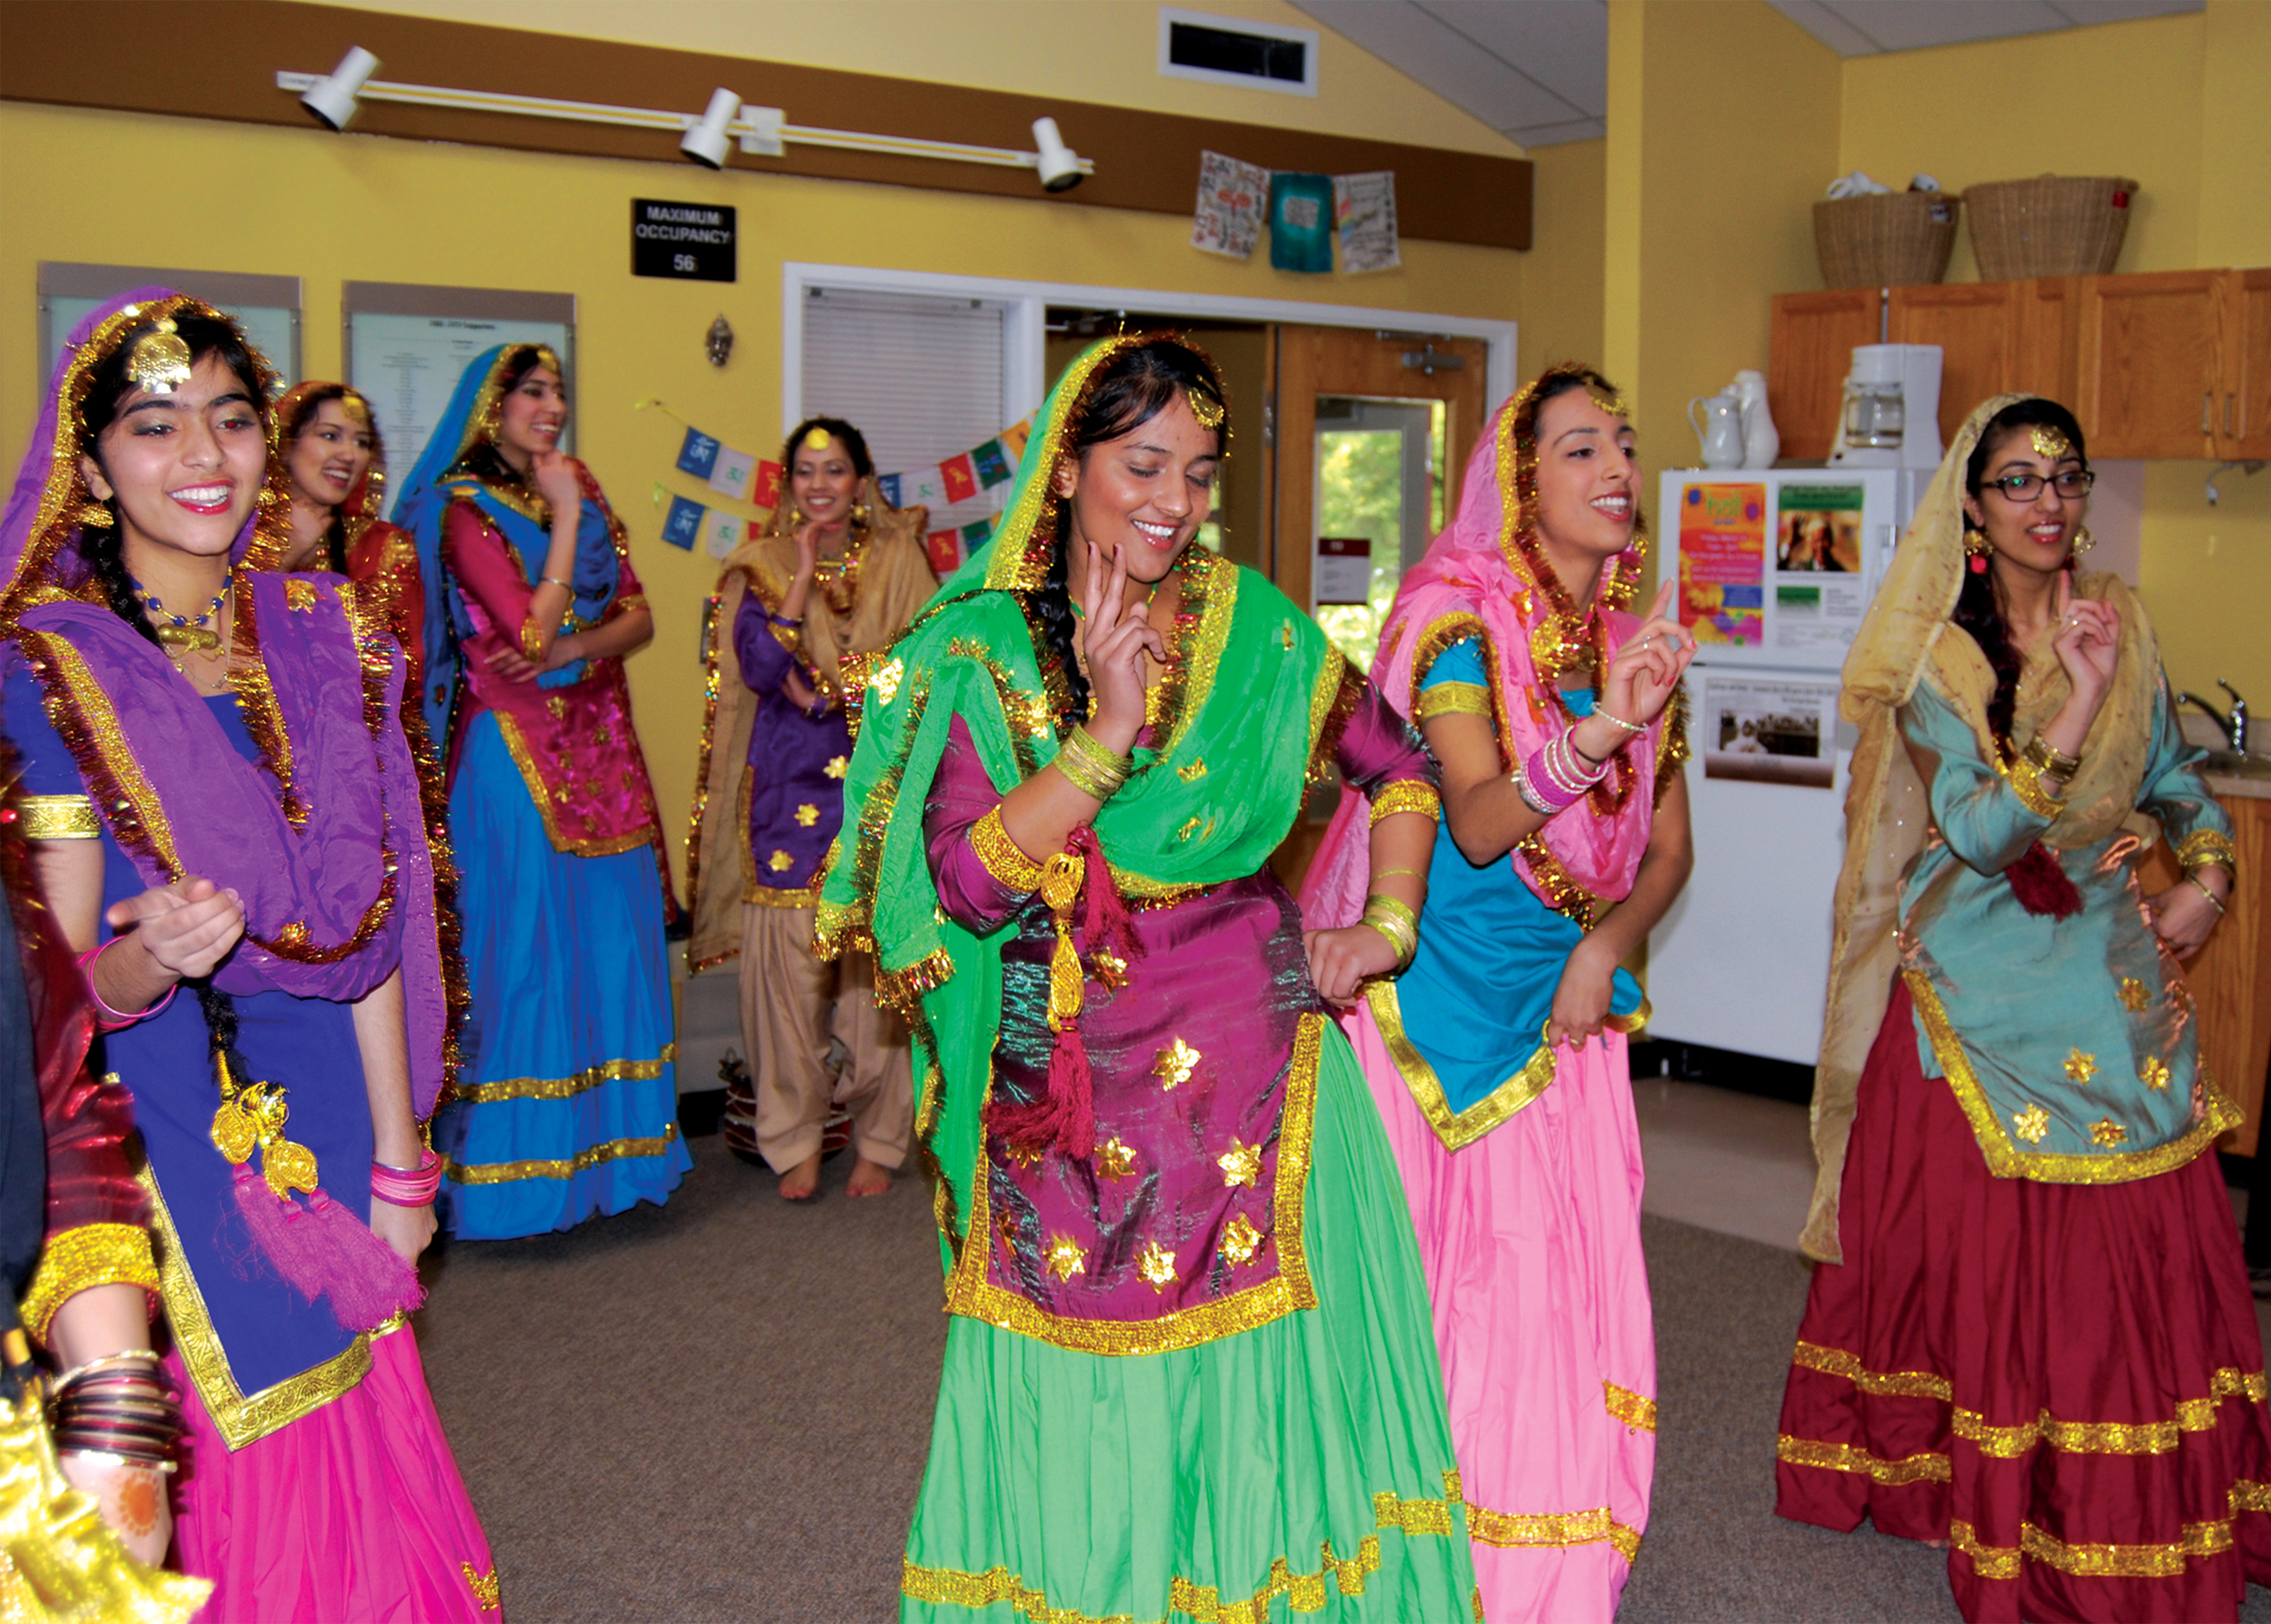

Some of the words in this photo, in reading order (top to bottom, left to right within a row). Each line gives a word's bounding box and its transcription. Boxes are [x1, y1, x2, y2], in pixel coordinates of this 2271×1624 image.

[646, 205, 720, 225] MAXIMUM
[636, 223, 730, 244] OCCUPANCY
[673, 254, 695, 272] 56
